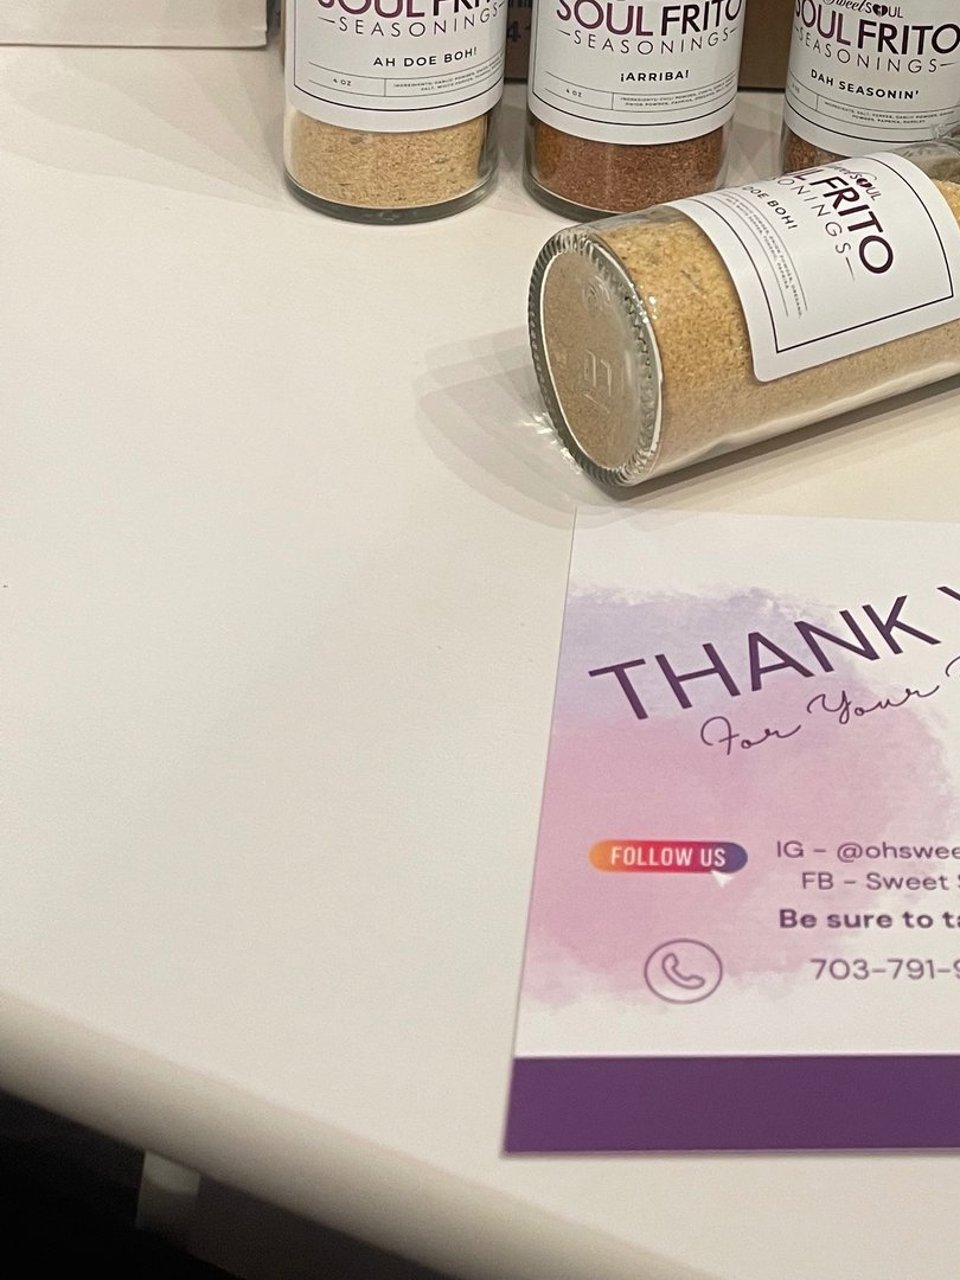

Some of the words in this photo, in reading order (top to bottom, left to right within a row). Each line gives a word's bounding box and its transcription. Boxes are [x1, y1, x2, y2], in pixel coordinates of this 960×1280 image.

[338, 0, 499, 38] SEASONINGS
[573, 26, 730, 56] SEASONINGS
[372, 55, 397, 68] AH
[403, 55, 437, 68] DOE
[444, 46, 478, 64] BOH!
[620, 70, 690, 83] ¡ARRIBA!
[810, 68, 835, 87] DAH
[838, 79, 920, 101] SEASONIN'
[809, 175, 894, 275] FRITO
[588, 594, 942, 721] THANK
[700, 715, 801, 756] For
[806, 684, 940, 725] Your
[610, 846, 693, 868] FOLLOW
[699, 847, 727, 869] US
[775, 839, 805, 860] IG
[800, 872, 835, 892] FB
[864, 872, 951, 893] Sweet
[778, 908, 818, 930] Be
[825, 913, 894, 930] sure
[901, 910, 934, 931] to
